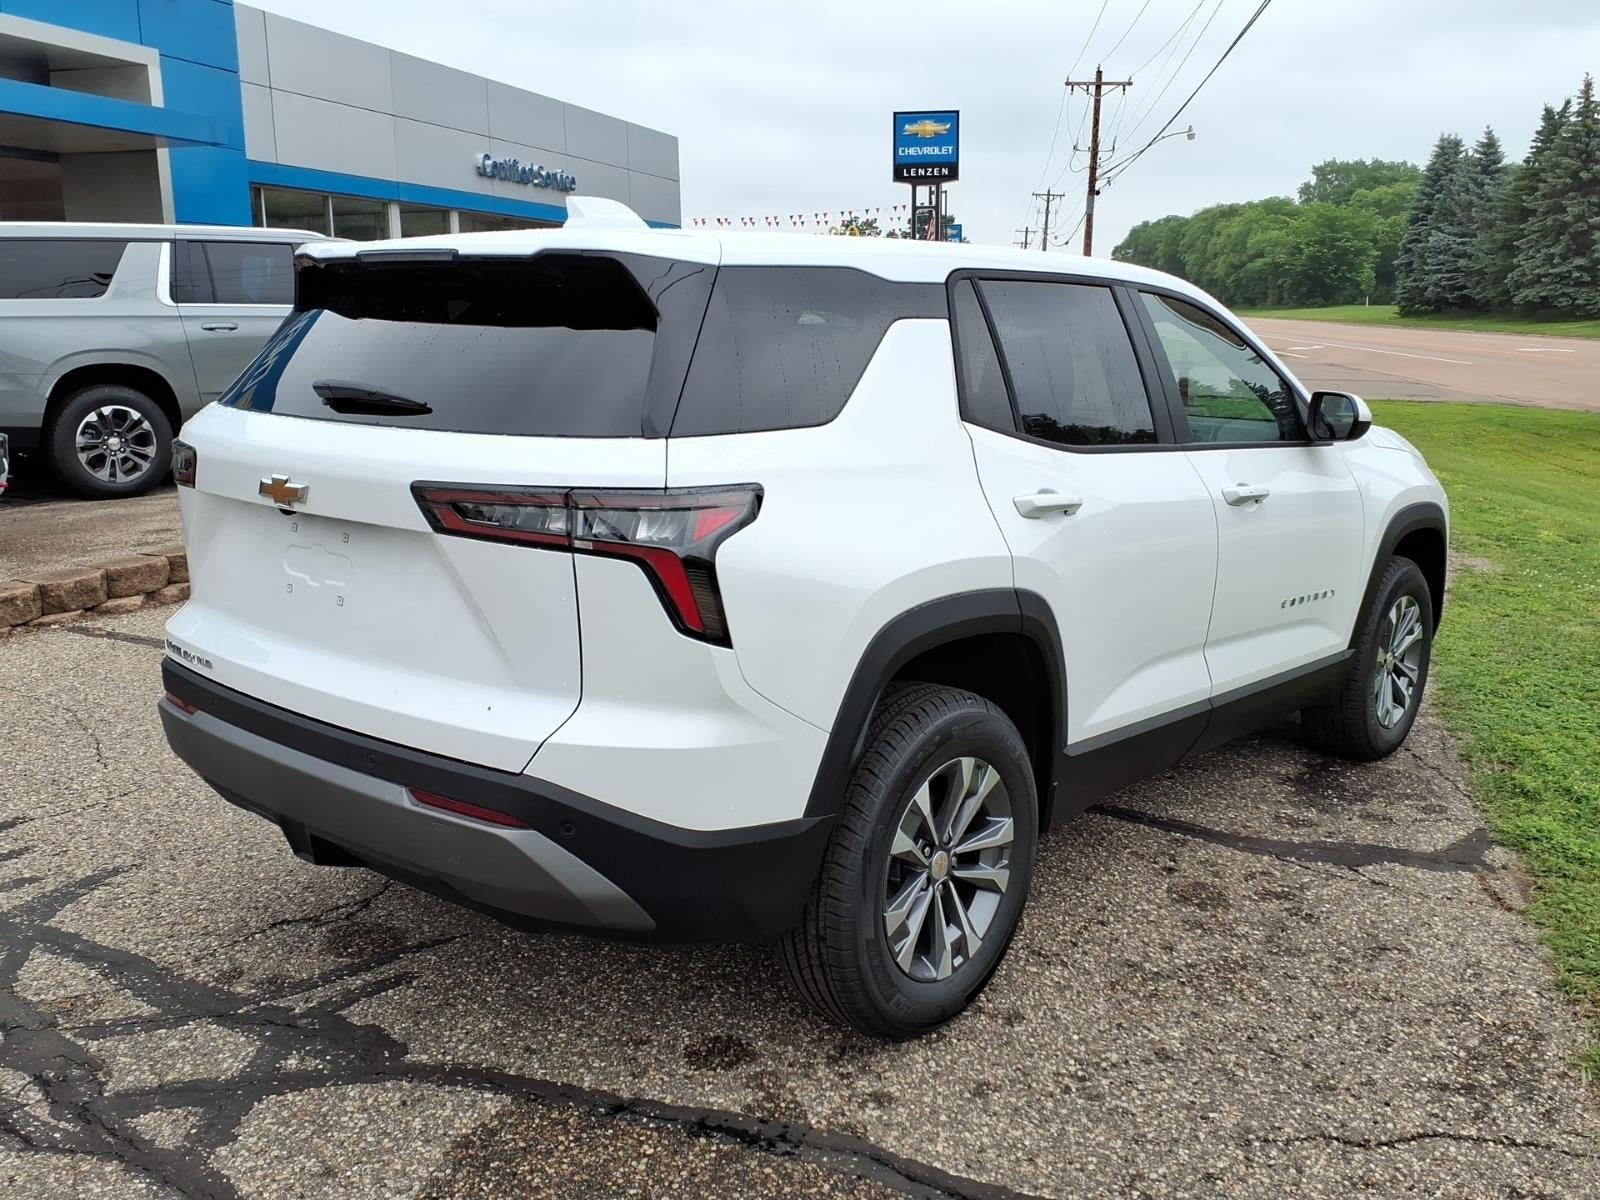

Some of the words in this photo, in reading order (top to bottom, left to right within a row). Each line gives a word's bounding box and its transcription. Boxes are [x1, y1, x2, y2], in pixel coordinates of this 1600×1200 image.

[899, 146, 953, 156] CHEVROLET
[480, 153, 534, 185] Certified
[533, 165, 576, 192] Service
[903, 167, 949, 177] LENZEN
